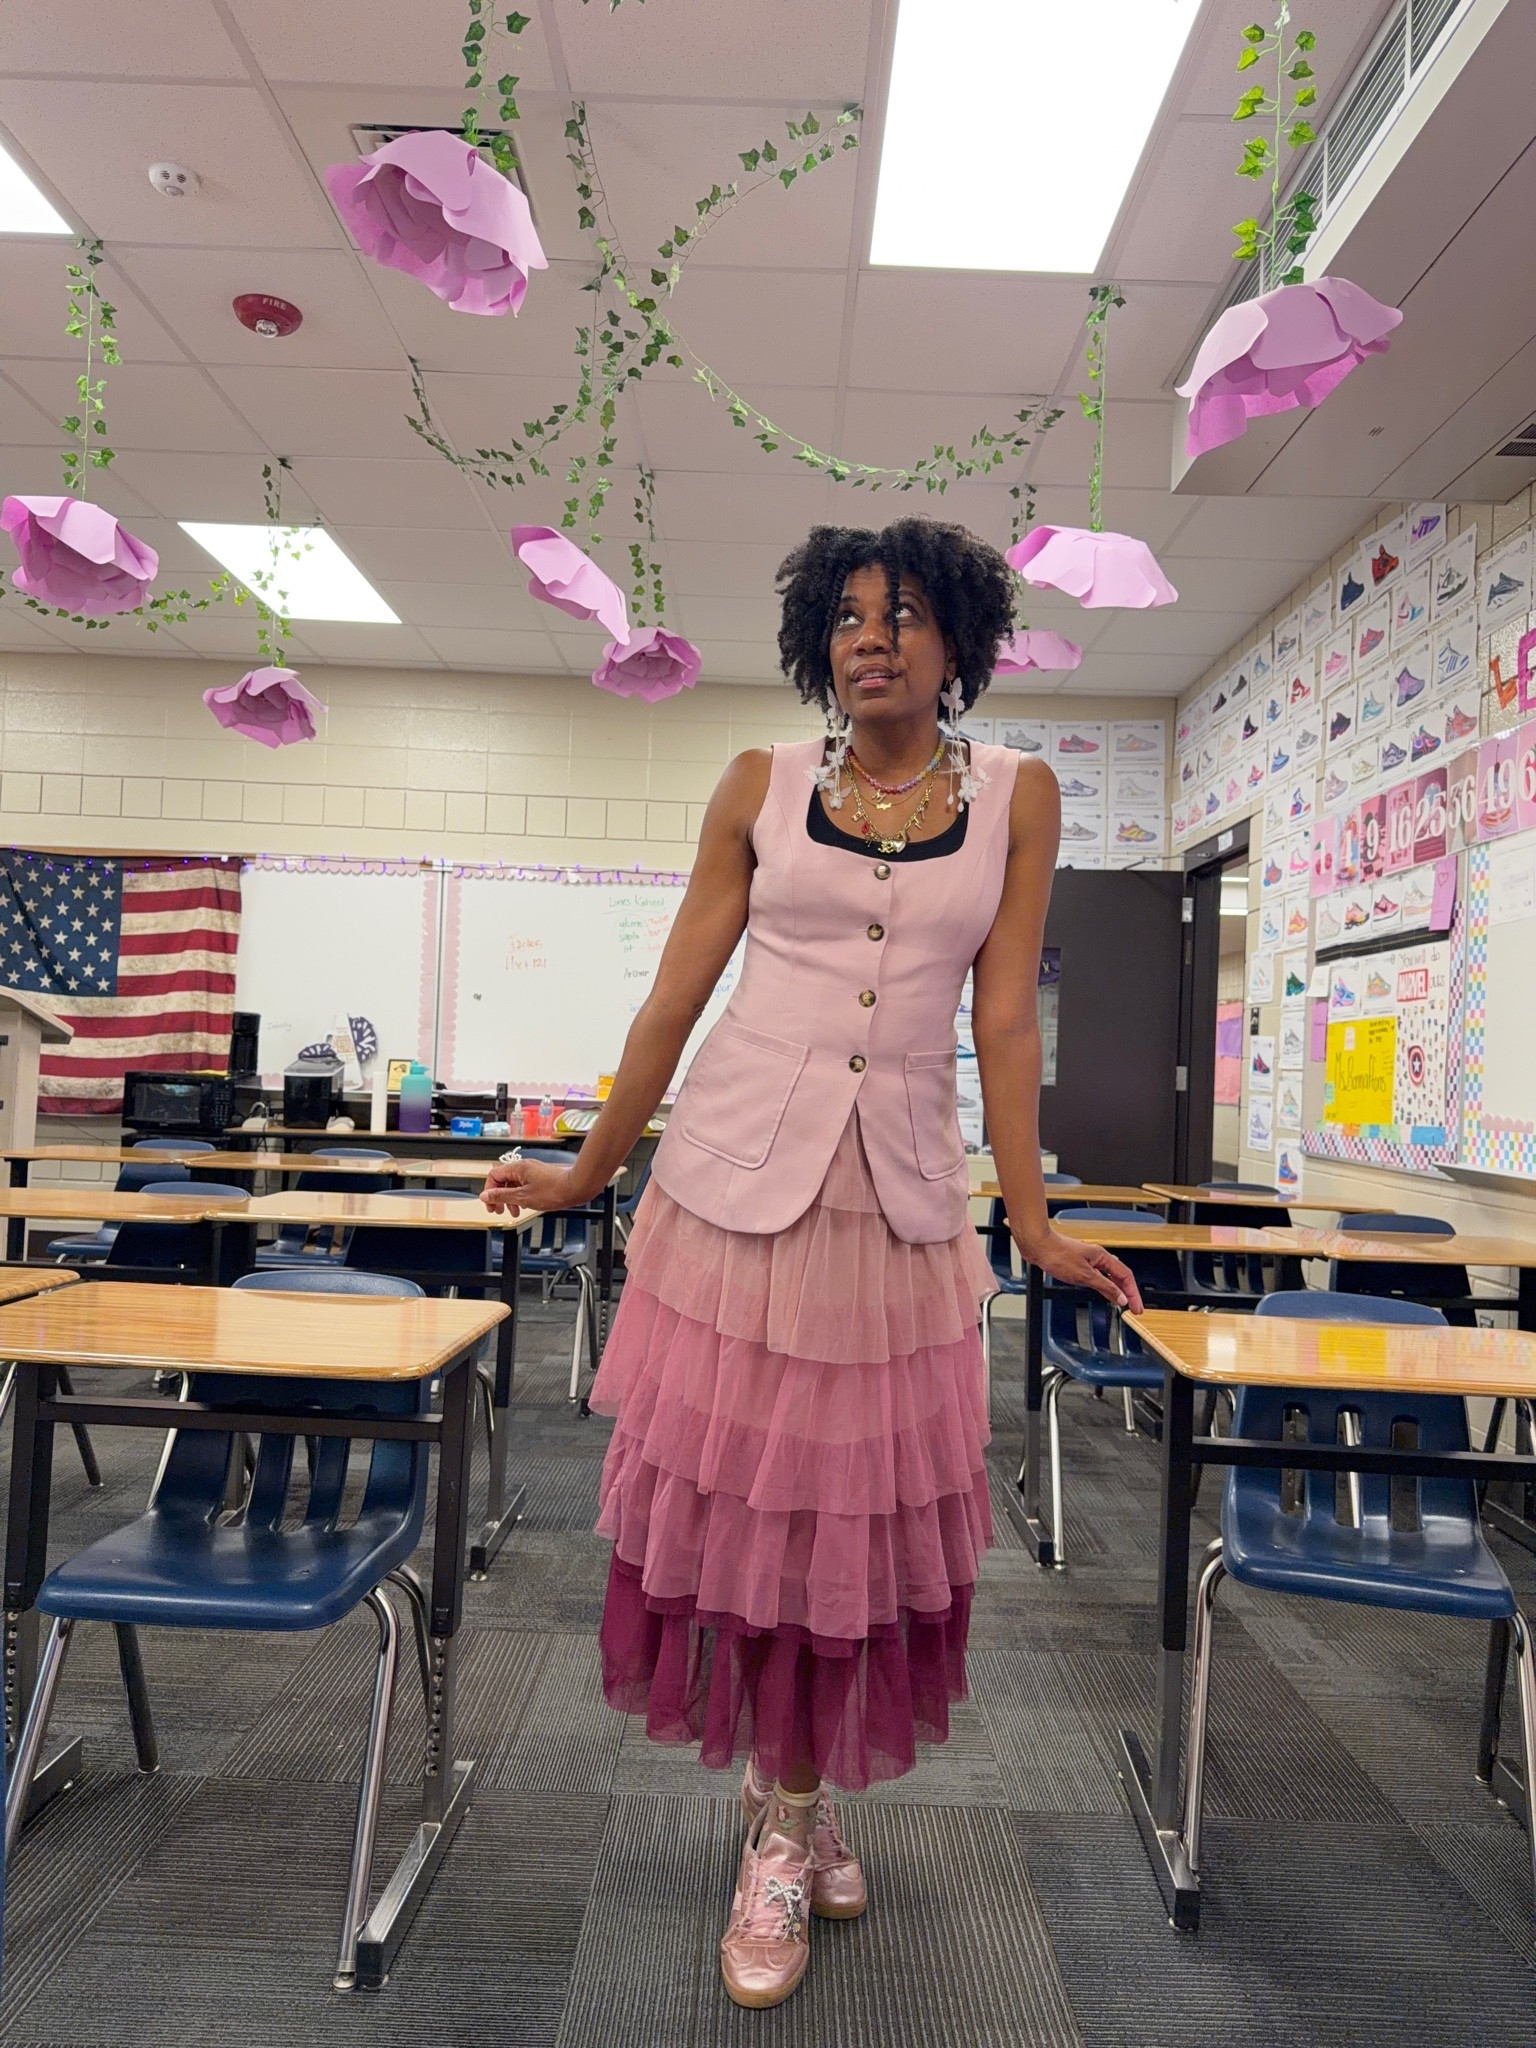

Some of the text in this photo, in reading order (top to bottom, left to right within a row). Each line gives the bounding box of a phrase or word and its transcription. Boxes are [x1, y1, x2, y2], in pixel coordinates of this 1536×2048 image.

[262, 297, 287, 310] FIRE
[1366, 819, 1379, 861] 9
[1389, 805, 1412, 853] 16
[1413, 790, 1447, 842] 25
[1448, 774, 1476, 829] 36
[1478, 758, 1516, 814] 49
